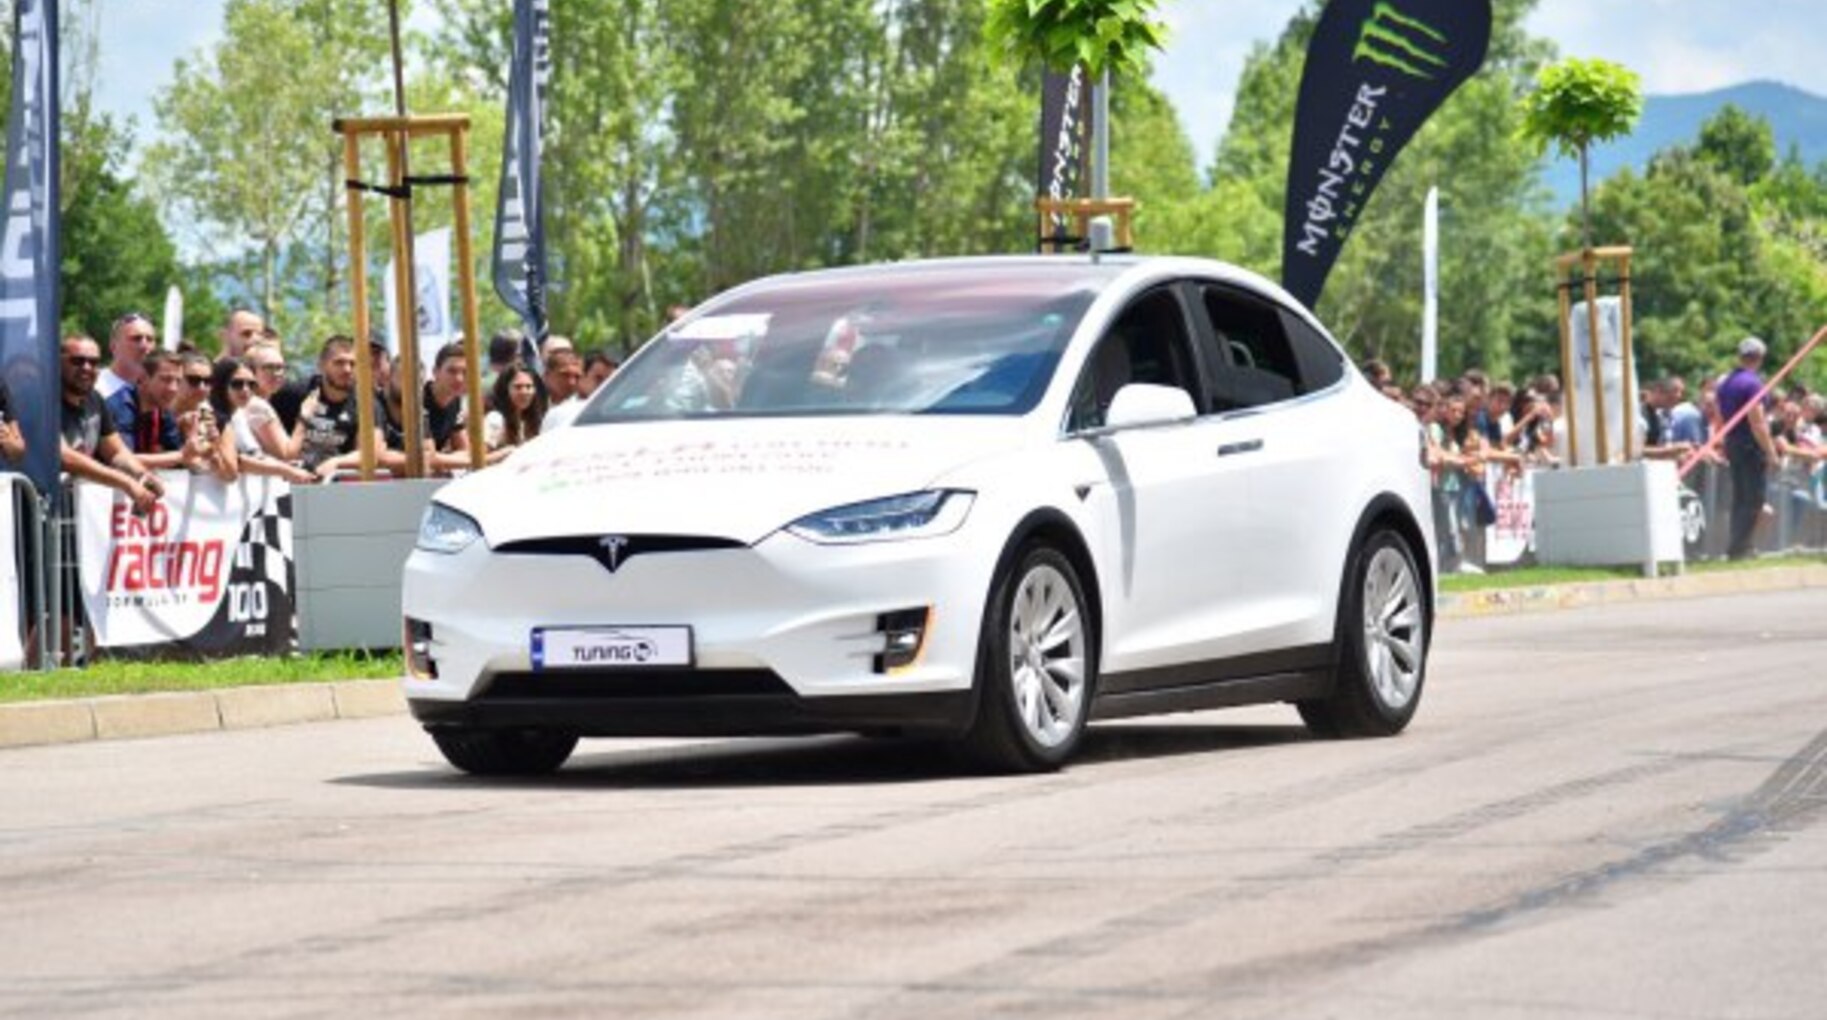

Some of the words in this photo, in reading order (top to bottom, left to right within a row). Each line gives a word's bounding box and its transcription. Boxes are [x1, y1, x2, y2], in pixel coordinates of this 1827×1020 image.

[1297, 82, 1387, 256] MONSTER
[1336, 117, 1390, 238] ENERGY
[111, 502, 168, 538] EKO
[106, 540, 223, 603] racing
[228, 582, 268, 622] 100
[573, 645, 632, 662] TUNING
